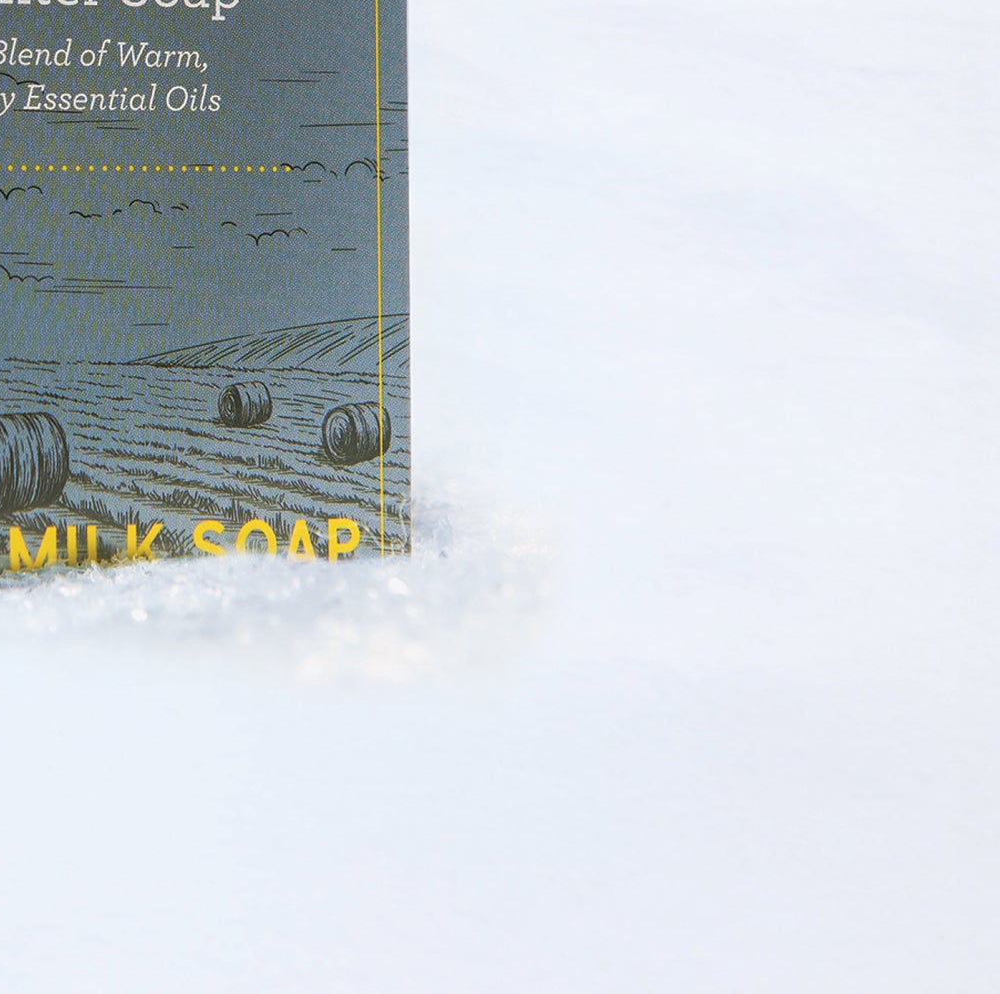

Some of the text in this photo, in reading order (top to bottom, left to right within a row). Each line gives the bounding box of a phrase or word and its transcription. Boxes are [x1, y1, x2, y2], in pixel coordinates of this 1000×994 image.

[79, 39, 111, 67] of
[117, 42, 209, 71] Warm,
[23, 84, 156, 112] Essential
[165, 84, 222, 112] Oils
[192, 518, 361, 564] SOAP
